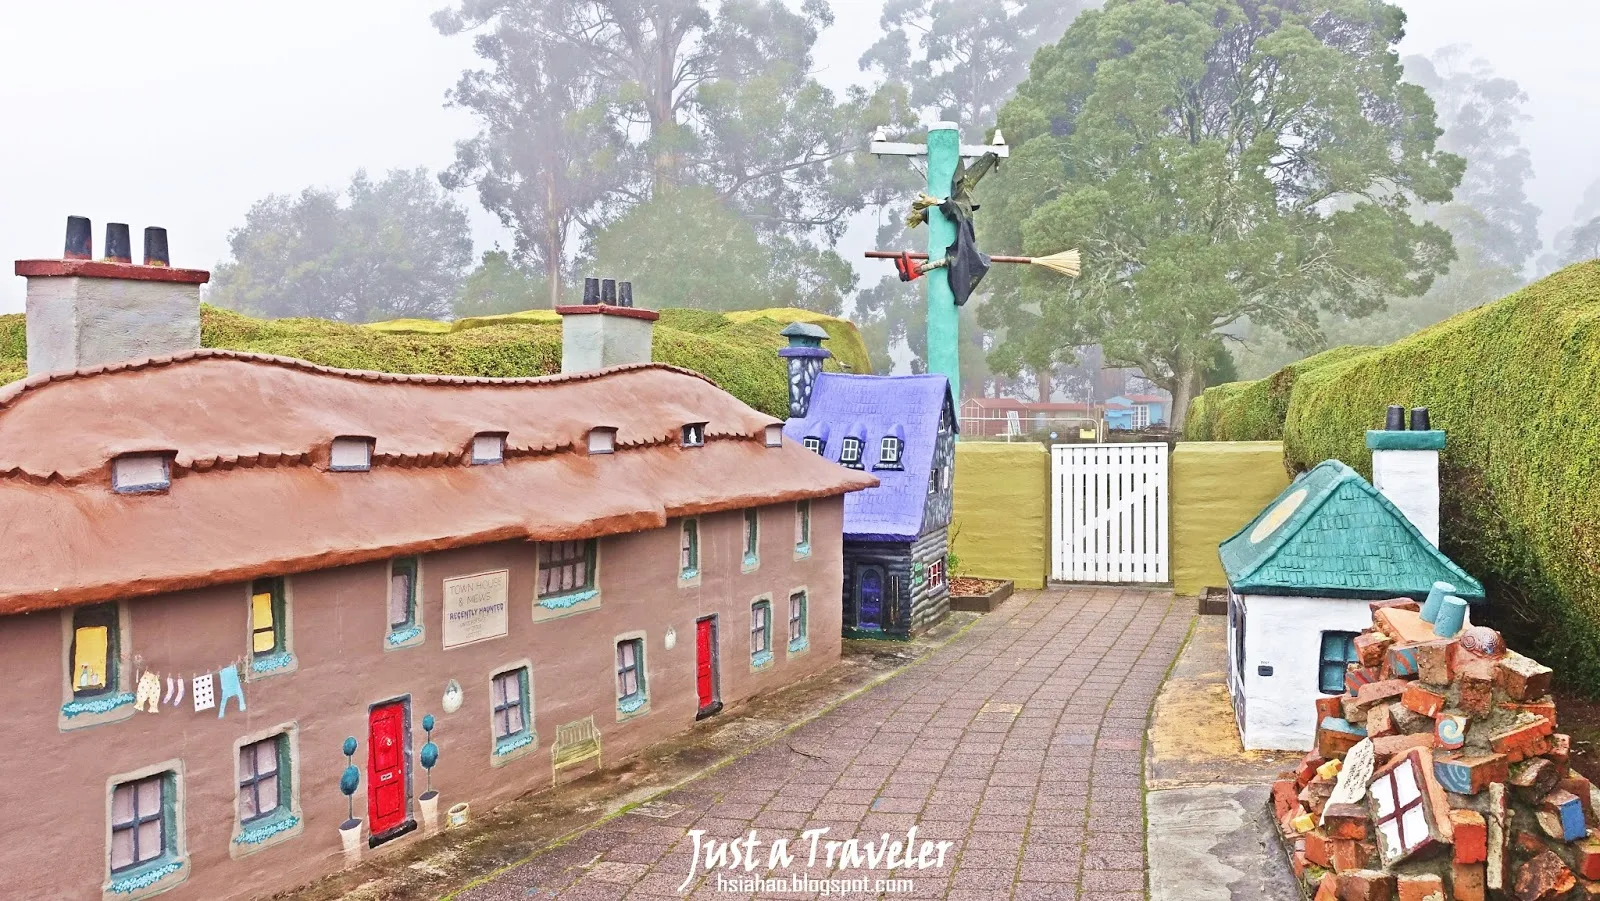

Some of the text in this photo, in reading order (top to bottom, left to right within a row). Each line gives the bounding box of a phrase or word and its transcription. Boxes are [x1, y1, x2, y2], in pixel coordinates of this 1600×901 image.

[449, 577, 502, 595] TOWN HOUSE
[458, 591, 492, 607] & MEWS
[449, 602, 504, 621] RECENTLY HAUNTED
